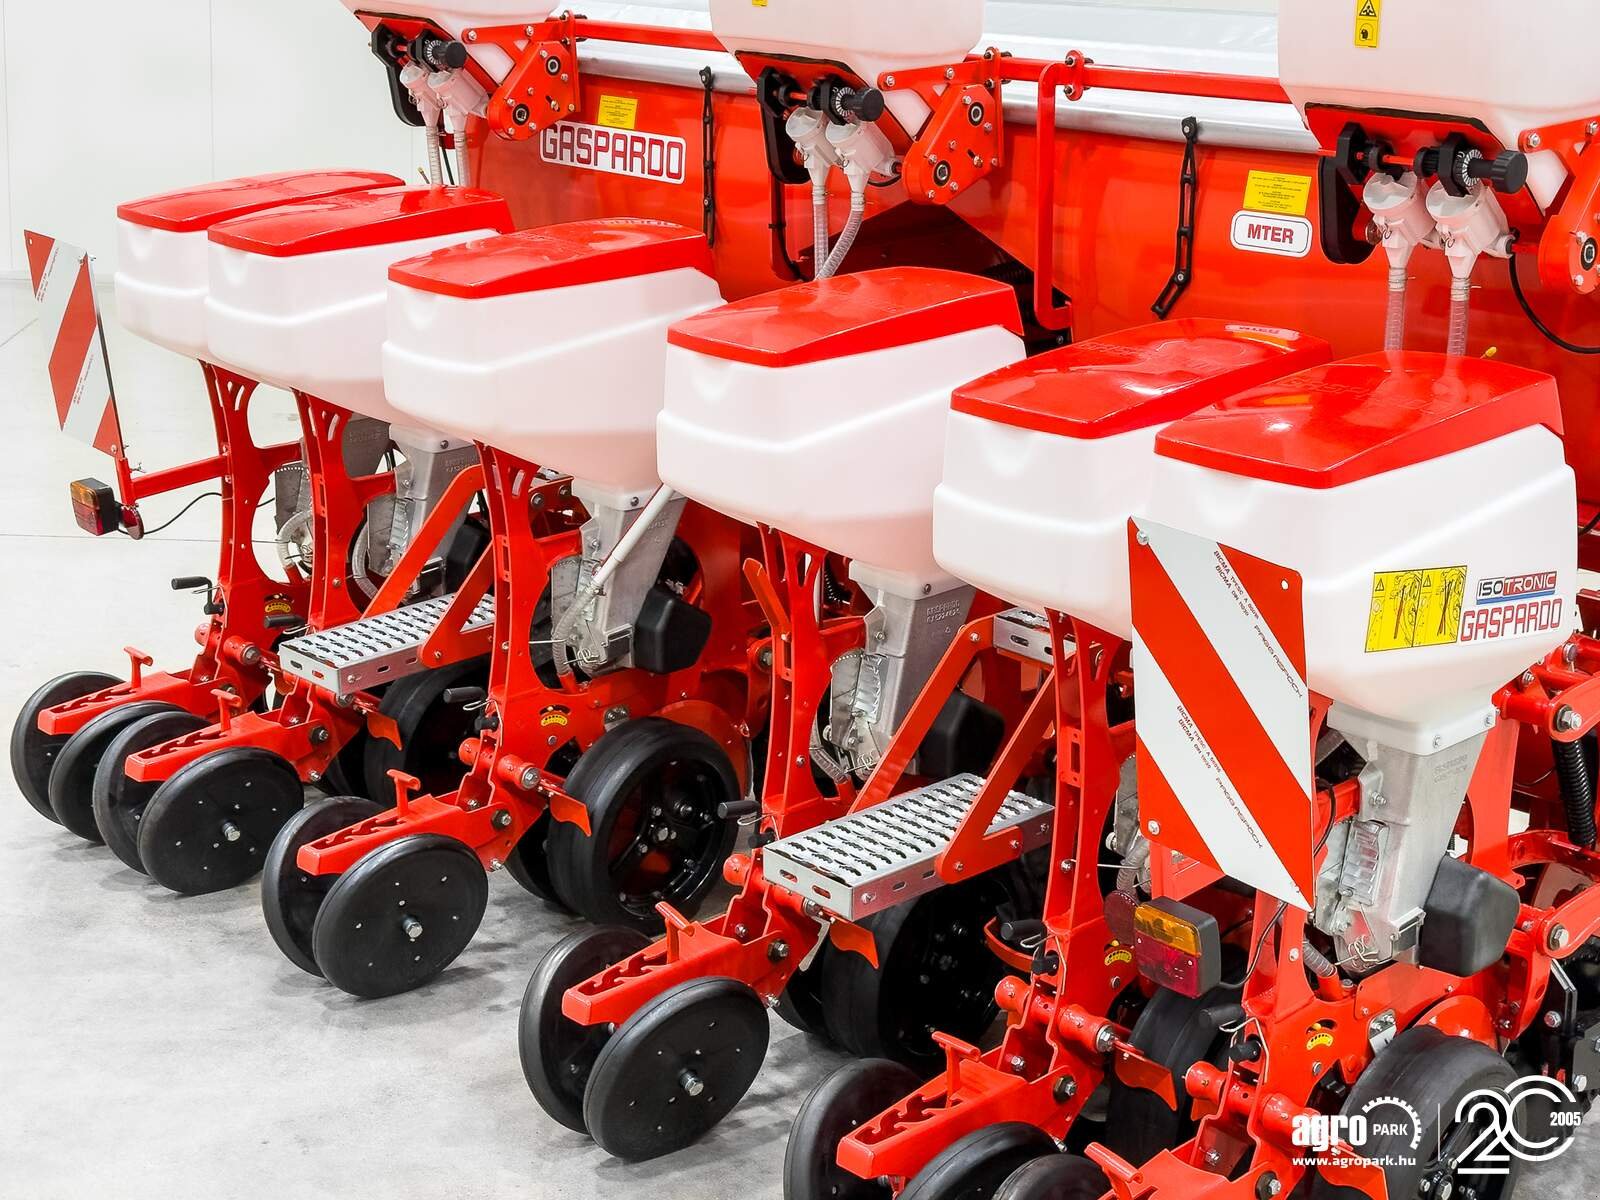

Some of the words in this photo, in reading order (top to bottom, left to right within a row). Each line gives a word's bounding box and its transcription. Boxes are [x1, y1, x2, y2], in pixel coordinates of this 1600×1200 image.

[543, 123, 683, 180] GASPARDO
[1248, 223, 1294, 244] MTER
[1478, 573, 1556, 597] ISOTRONIC
[1461, 598, 1562, 642] GASPARDO
